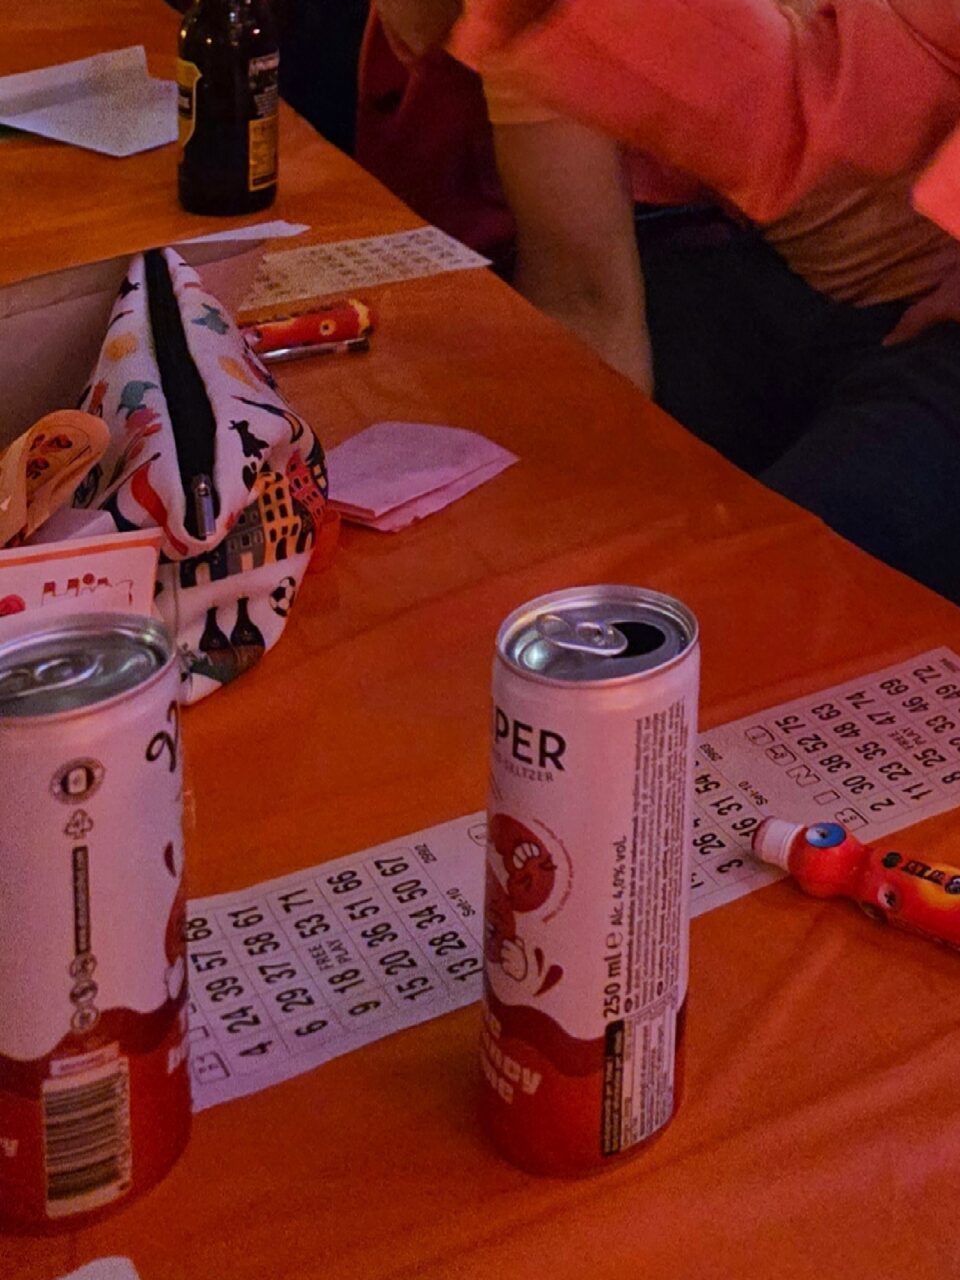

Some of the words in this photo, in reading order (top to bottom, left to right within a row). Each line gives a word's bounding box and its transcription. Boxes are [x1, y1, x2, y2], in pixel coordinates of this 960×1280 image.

[912, 665, 942, 684] 72
[879, 678, 909, 696] 69
[845, 690, 875, 710] 74
[901, 696, 930, 714] 46
[811, 703, 841, 721] 63
[866, 711, 897, 725] 47
[775, 715, 806, 734] 75
[833, 721, 861, 738] 48
[925, 715, 956, 734] 33
[797, 733, 828, 754] 52
[900, 727, 927, 746] PLAY
[854, 741, 888, 760] 35
[913, 747, 947, 768] 25
[819, 754, 852, 773] 38
[878, 761, 912, 781] 23
[695, 773, 721, 795] 54
[842, 775, 875, 795] 30
[901, 782, 933, 800] 11
[709, 795, 743, 816] 31
[869, 797, 895, 811] 2
[731, 817, 758, 837] 16
[693, 832, 726, 856] 26
[374, 856, 410, 877] 67
[716, 858, 744, 874] 3
[327, 870, 362, 895] 66
[392, 879, 428, 904] 50
[278, 889, 314, 914] 71
[344, 896, 380, 921] 51
[446, 887, 476, 918] Set-10
[227, 906, 264, 930] 61
[294, 913, 330, 939] 53
[408, 904, 446, 930] 34
[183, 917, 212, 942] 68
[361, 922, 398, 948] 36
[243, 931, 281, 956] 58
[326, 939, 353, 965] PLAY
[428, 930, 467, 956] 28
[191, 950, 228, 973] 57
[308, 944, 335, 971] FREE
[379, 949, 418, 976] 20
[604, 953, 622, 978] ml
[258, 962, 297, 984] 37
[447, 957, 484, 982] 13
[206, 976, 244, 1002] 39
[328, 968, 365, 994] 18
[396, 976, 435, 1001] 15
[275, 987, 315, 1013] 29
[604, 983, 621, 1018] 250
[220, 1006, 261, 1034] 24
[239, 1040, 273, 1057] 4
